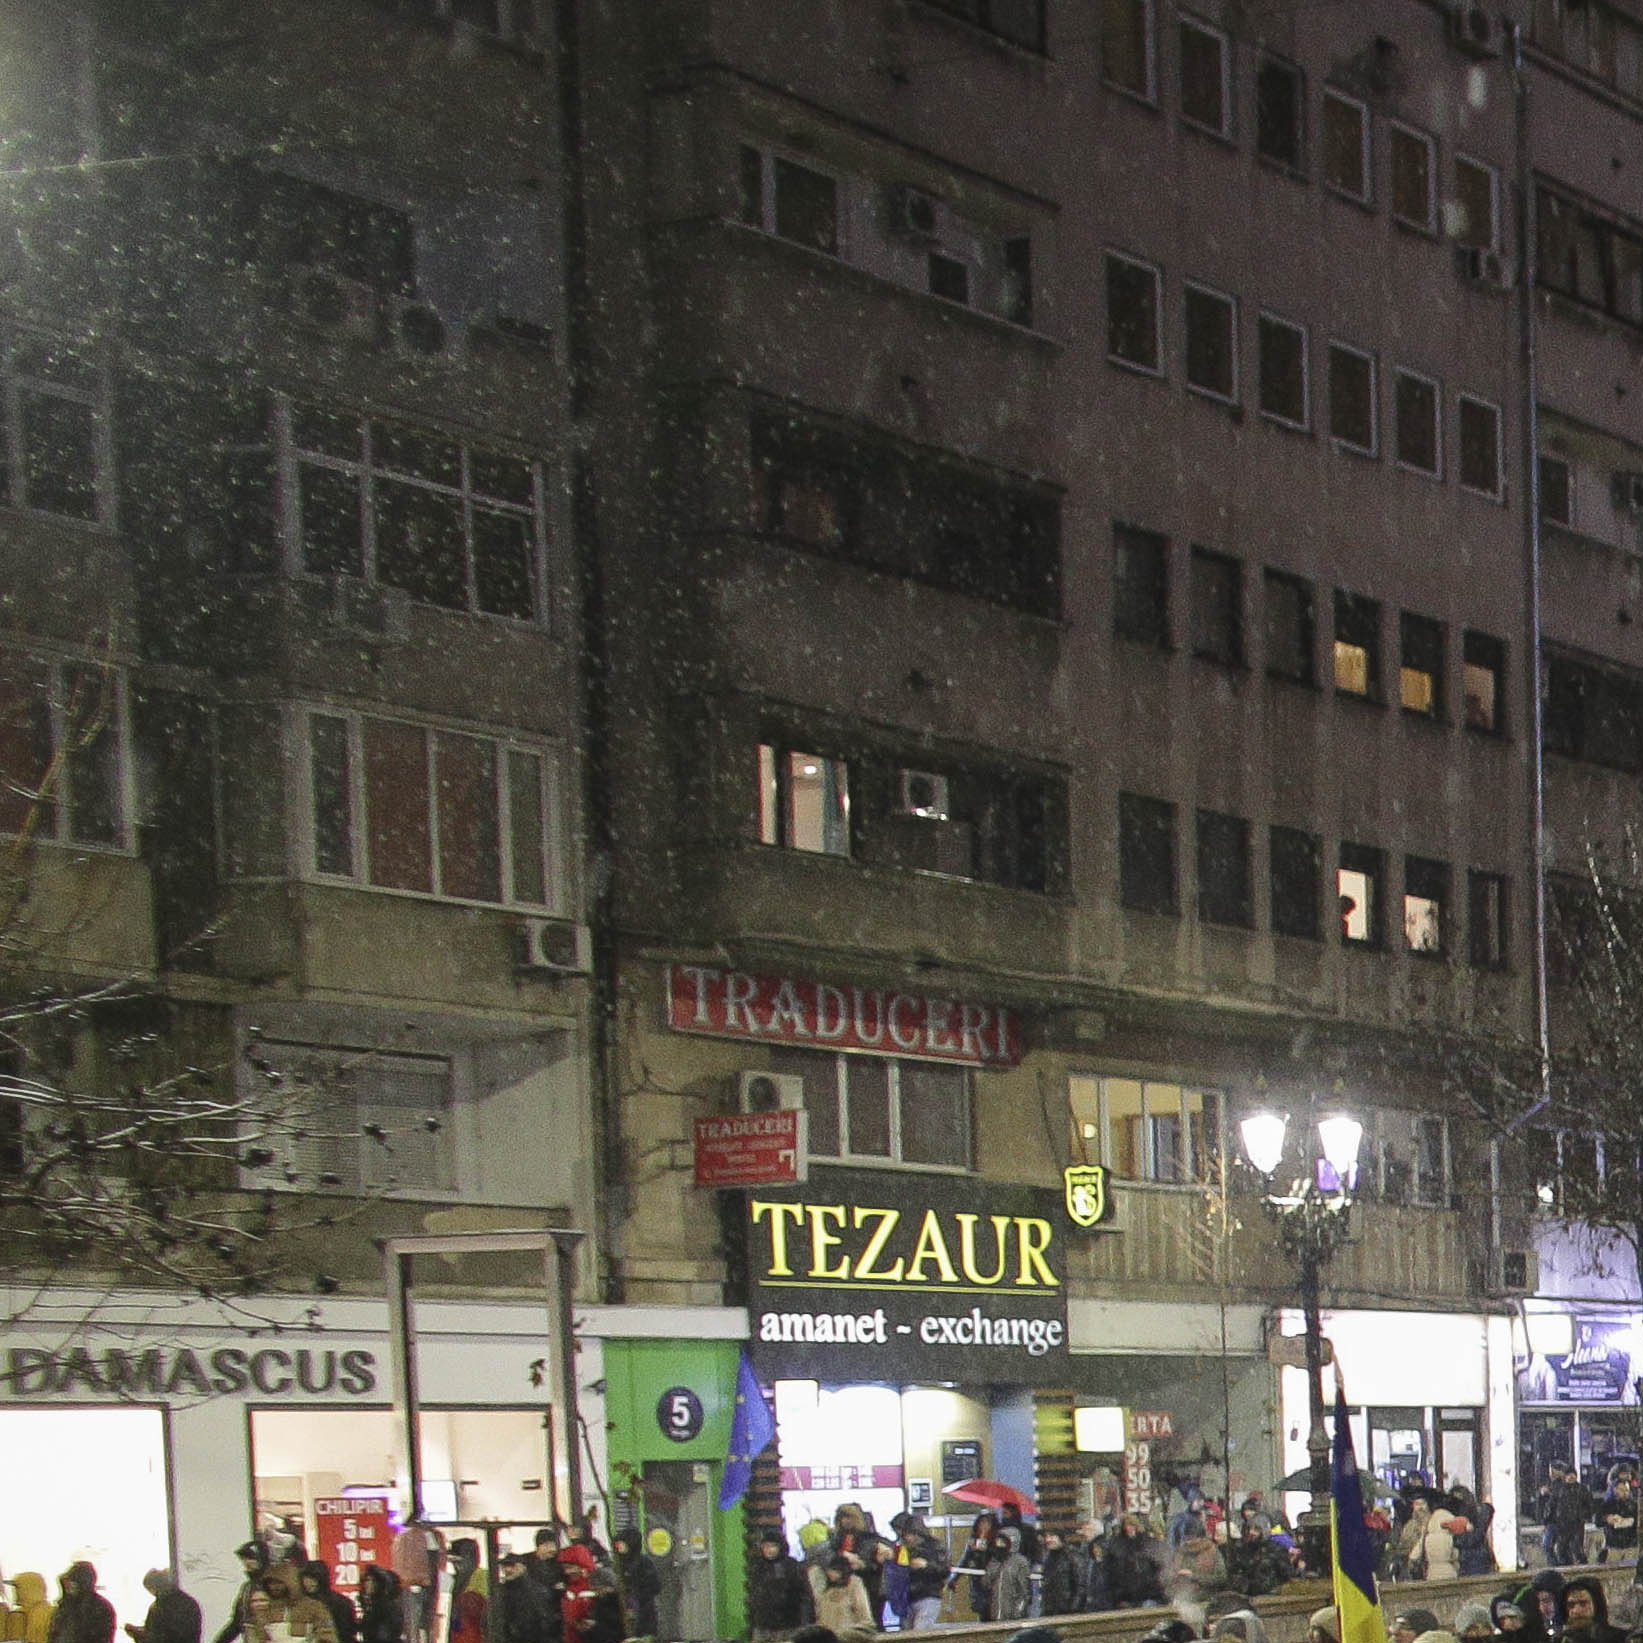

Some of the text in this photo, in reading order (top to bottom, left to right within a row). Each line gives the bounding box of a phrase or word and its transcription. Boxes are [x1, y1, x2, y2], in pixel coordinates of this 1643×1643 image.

[680, 964, 1010, 1060] TRADUCERI
[751, 1200, 1061, 1286] TEZAUR
[759, 1308, 888, 1344] amanet
[920, 1306, 1063, 1356] exchange
[8, 1348, 377, 1395] DAMASCUS
[671, 1395, 690, 1427] 5
